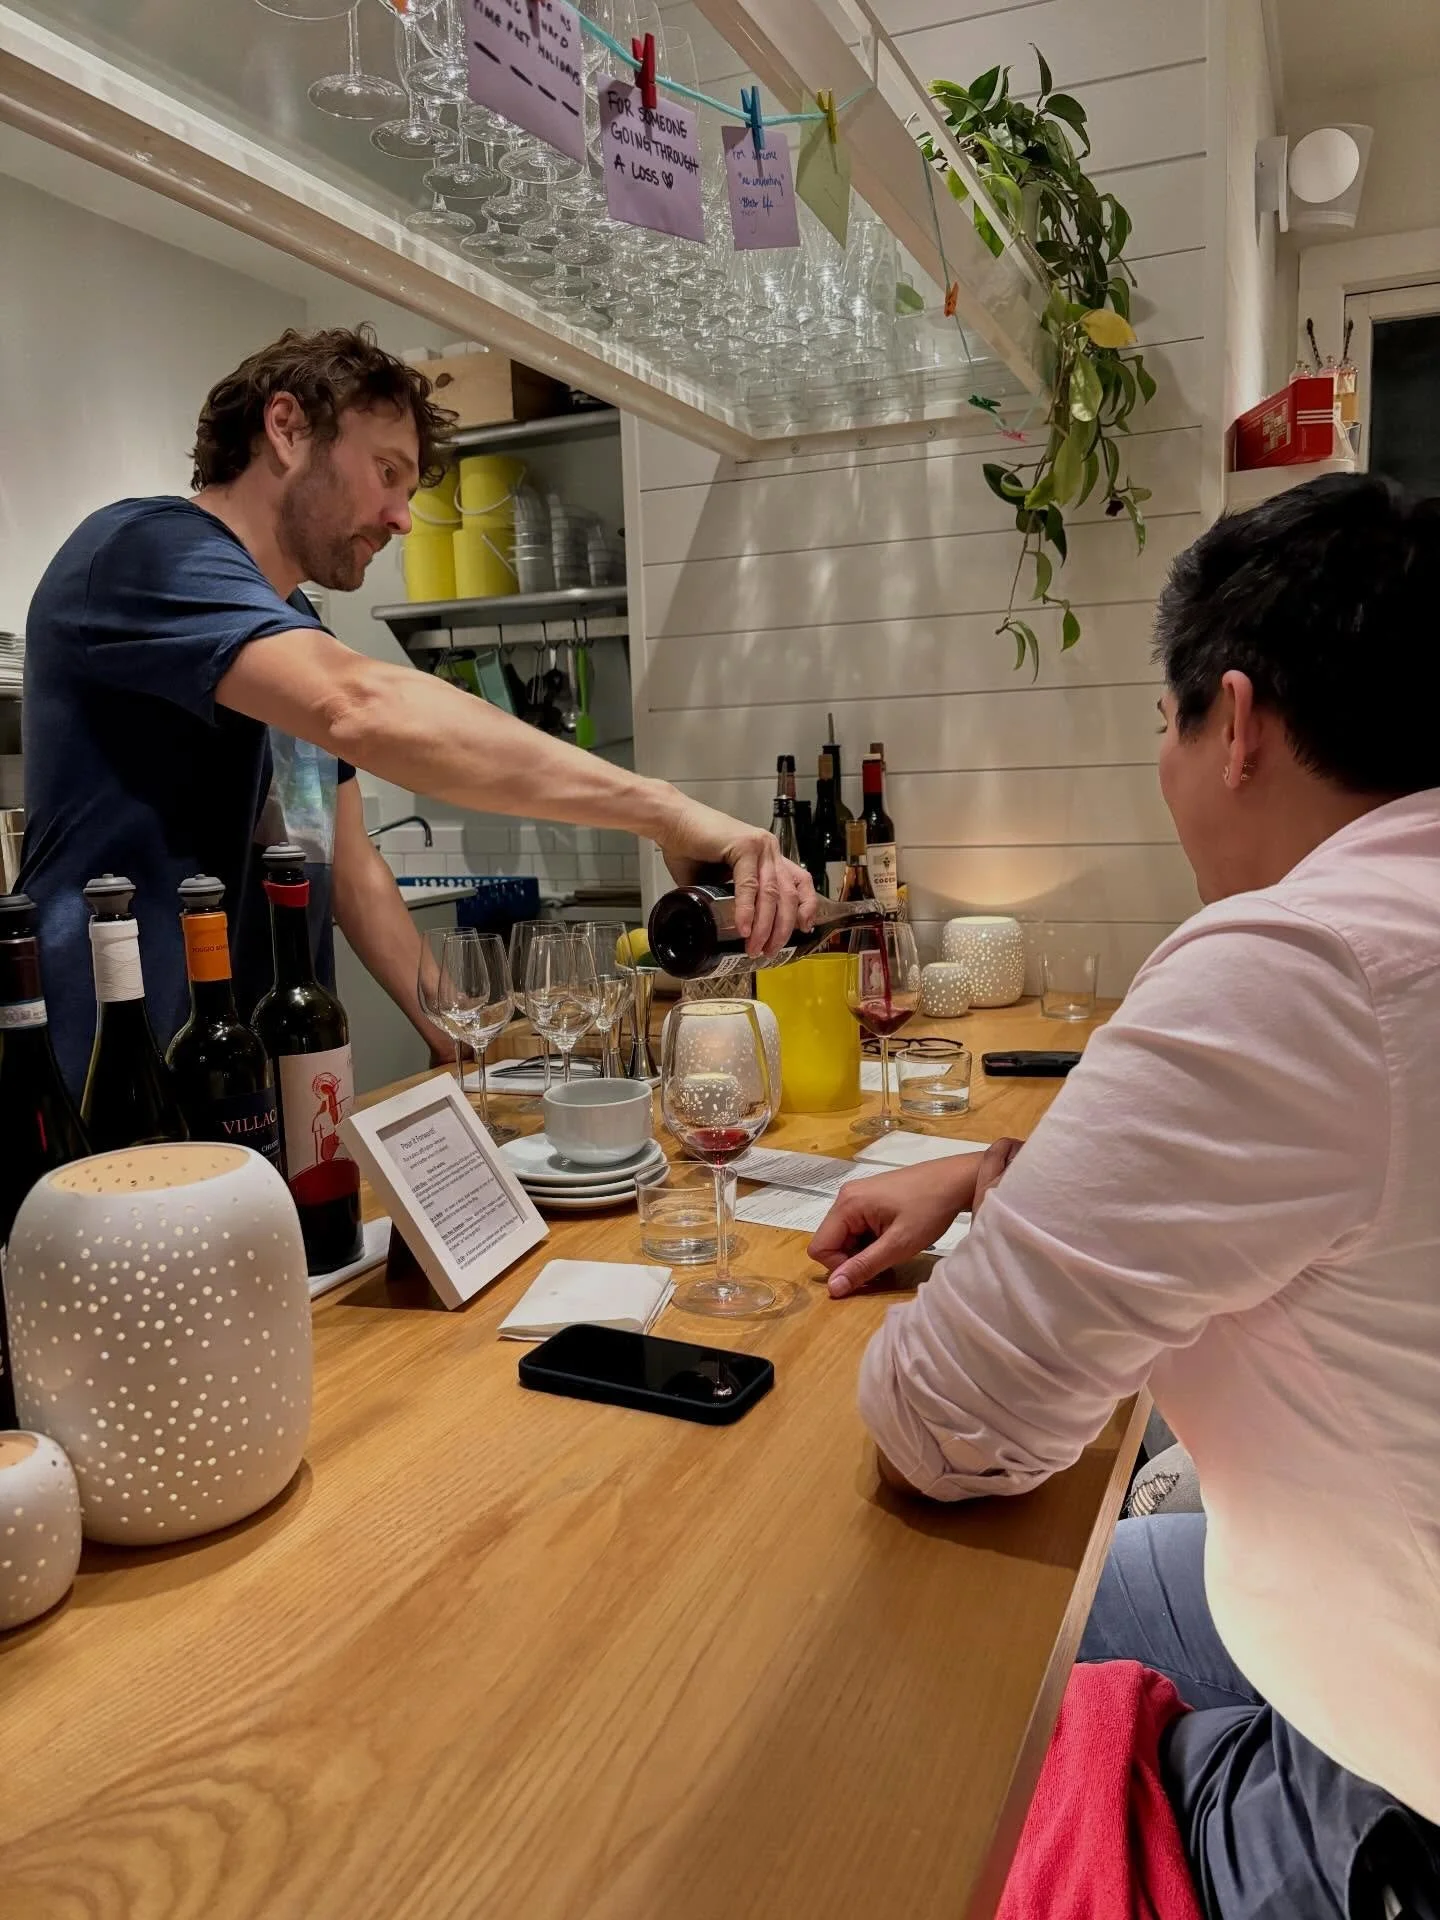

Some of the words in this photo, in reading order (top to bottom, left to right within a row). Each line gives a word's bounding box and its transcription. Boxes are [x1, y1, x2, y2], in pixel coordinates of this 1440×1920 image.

[507, 20, 531, 48] PAST
[538, 42, 580, 87] HOLIDAYS
[607, 90, 634, 117] FOR
[638, 106, 687, 139] SOMEONE
[611, 121, 652, 156] GOING
[652, 140, 699, 176] THROUGH
[613, 154, 625, 174] A
[631, 161, 660, 186] LOSS
